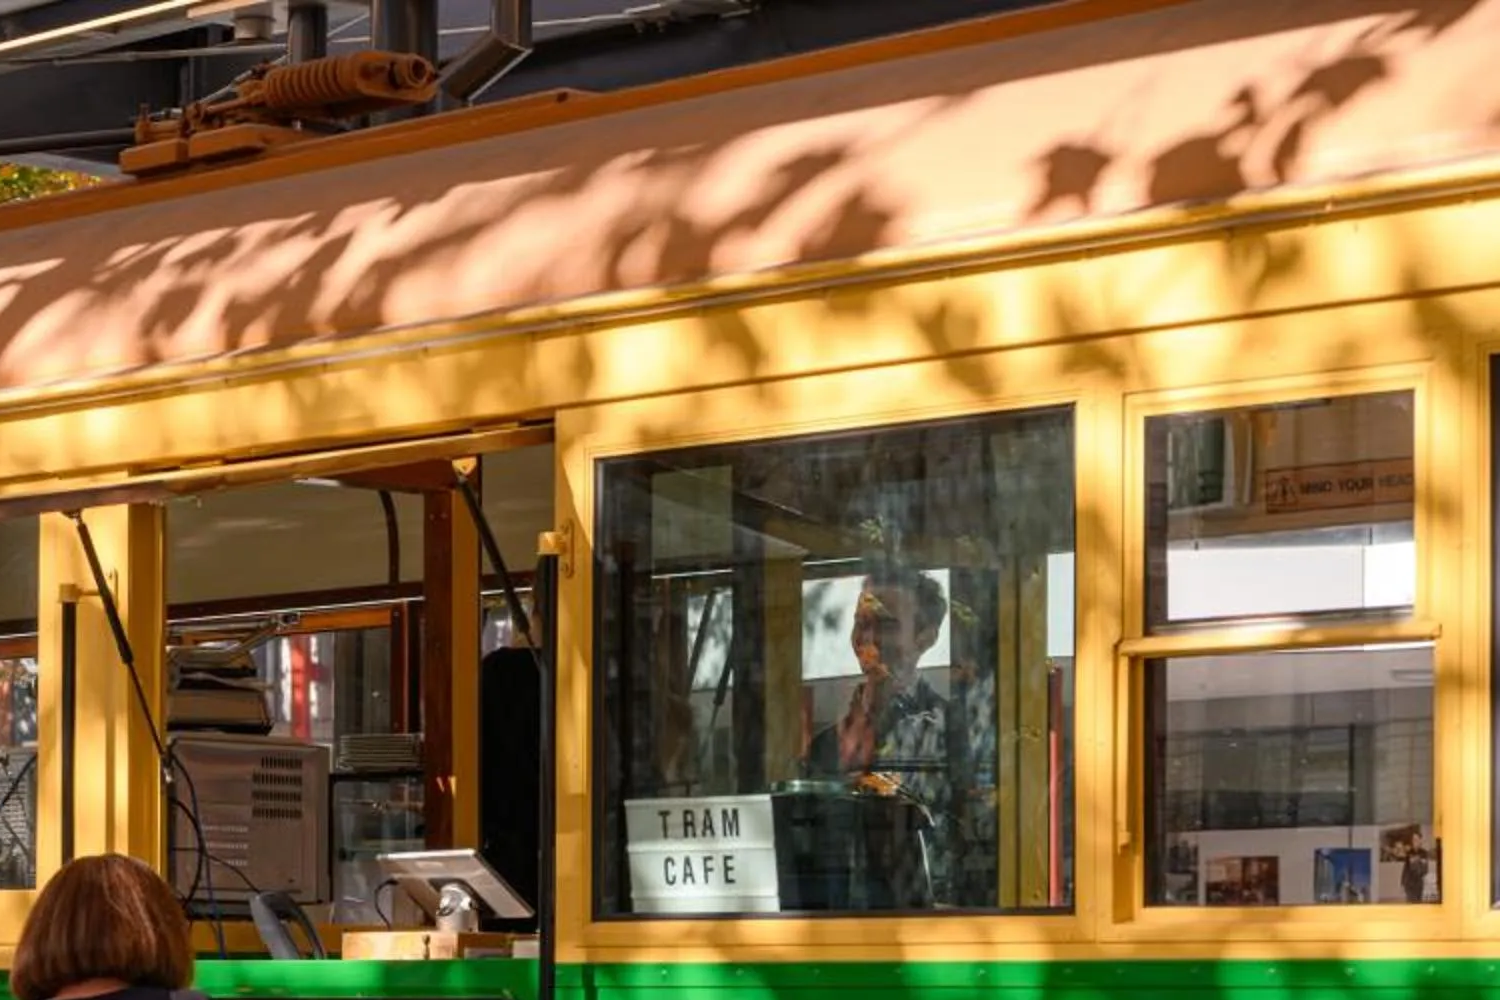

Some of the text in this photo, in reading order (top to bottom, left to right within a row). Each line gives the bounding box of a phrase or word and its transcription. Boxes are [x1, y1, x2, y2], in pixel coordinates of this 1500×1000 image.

[1337, 477, 1374, 492] YOUR
[657, 807, 741, 839] TRAM
[663, 855, 737, 885] CAFE
